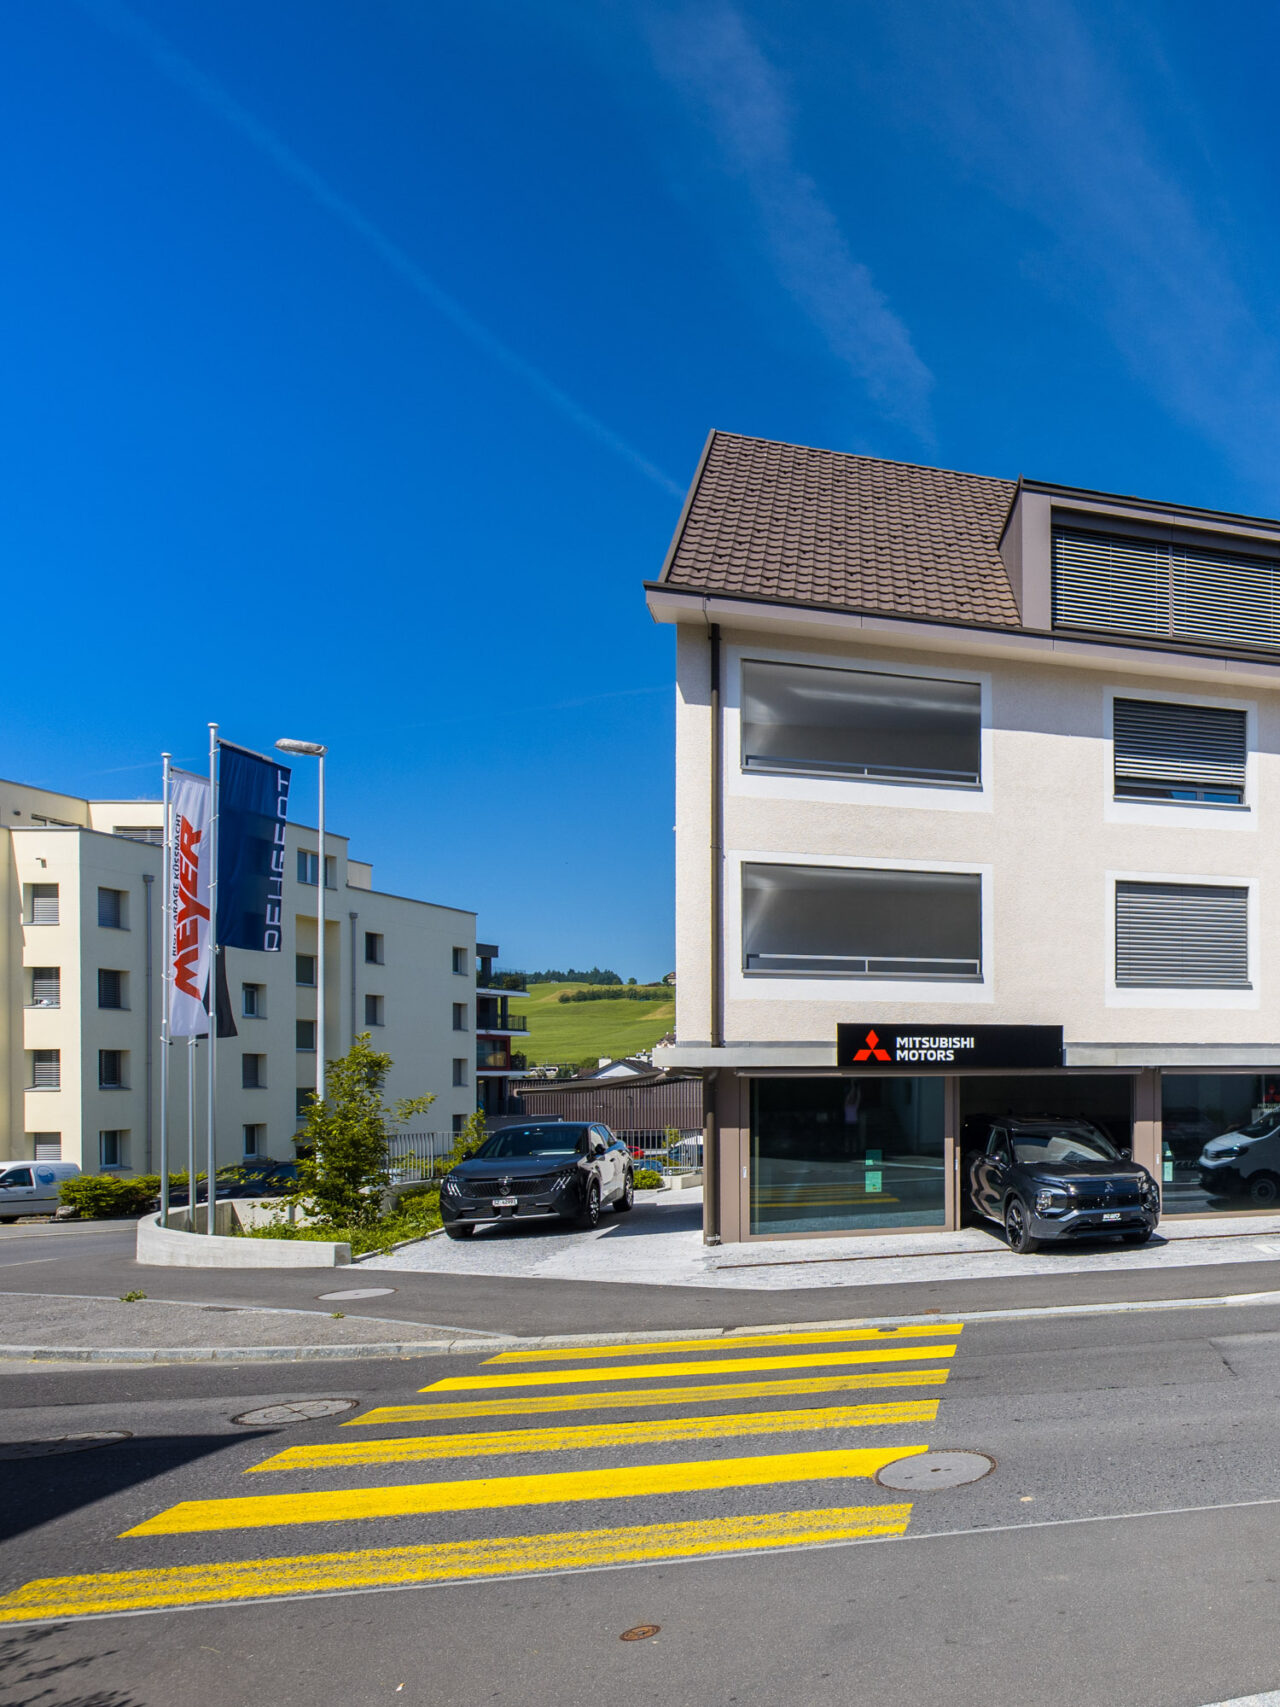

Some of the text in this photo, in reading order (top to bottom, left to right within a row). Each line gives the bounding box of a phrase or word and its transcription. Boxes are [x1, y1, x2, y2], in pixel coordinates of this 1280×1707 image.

[173, 812, 181, 880] KÜSSNACHT
[173, 815, 210, 1001] MEYER
[896, 1037, 974, 1048] MITSUBISHI
[896, 1050, 954, 1061] MOTORS
